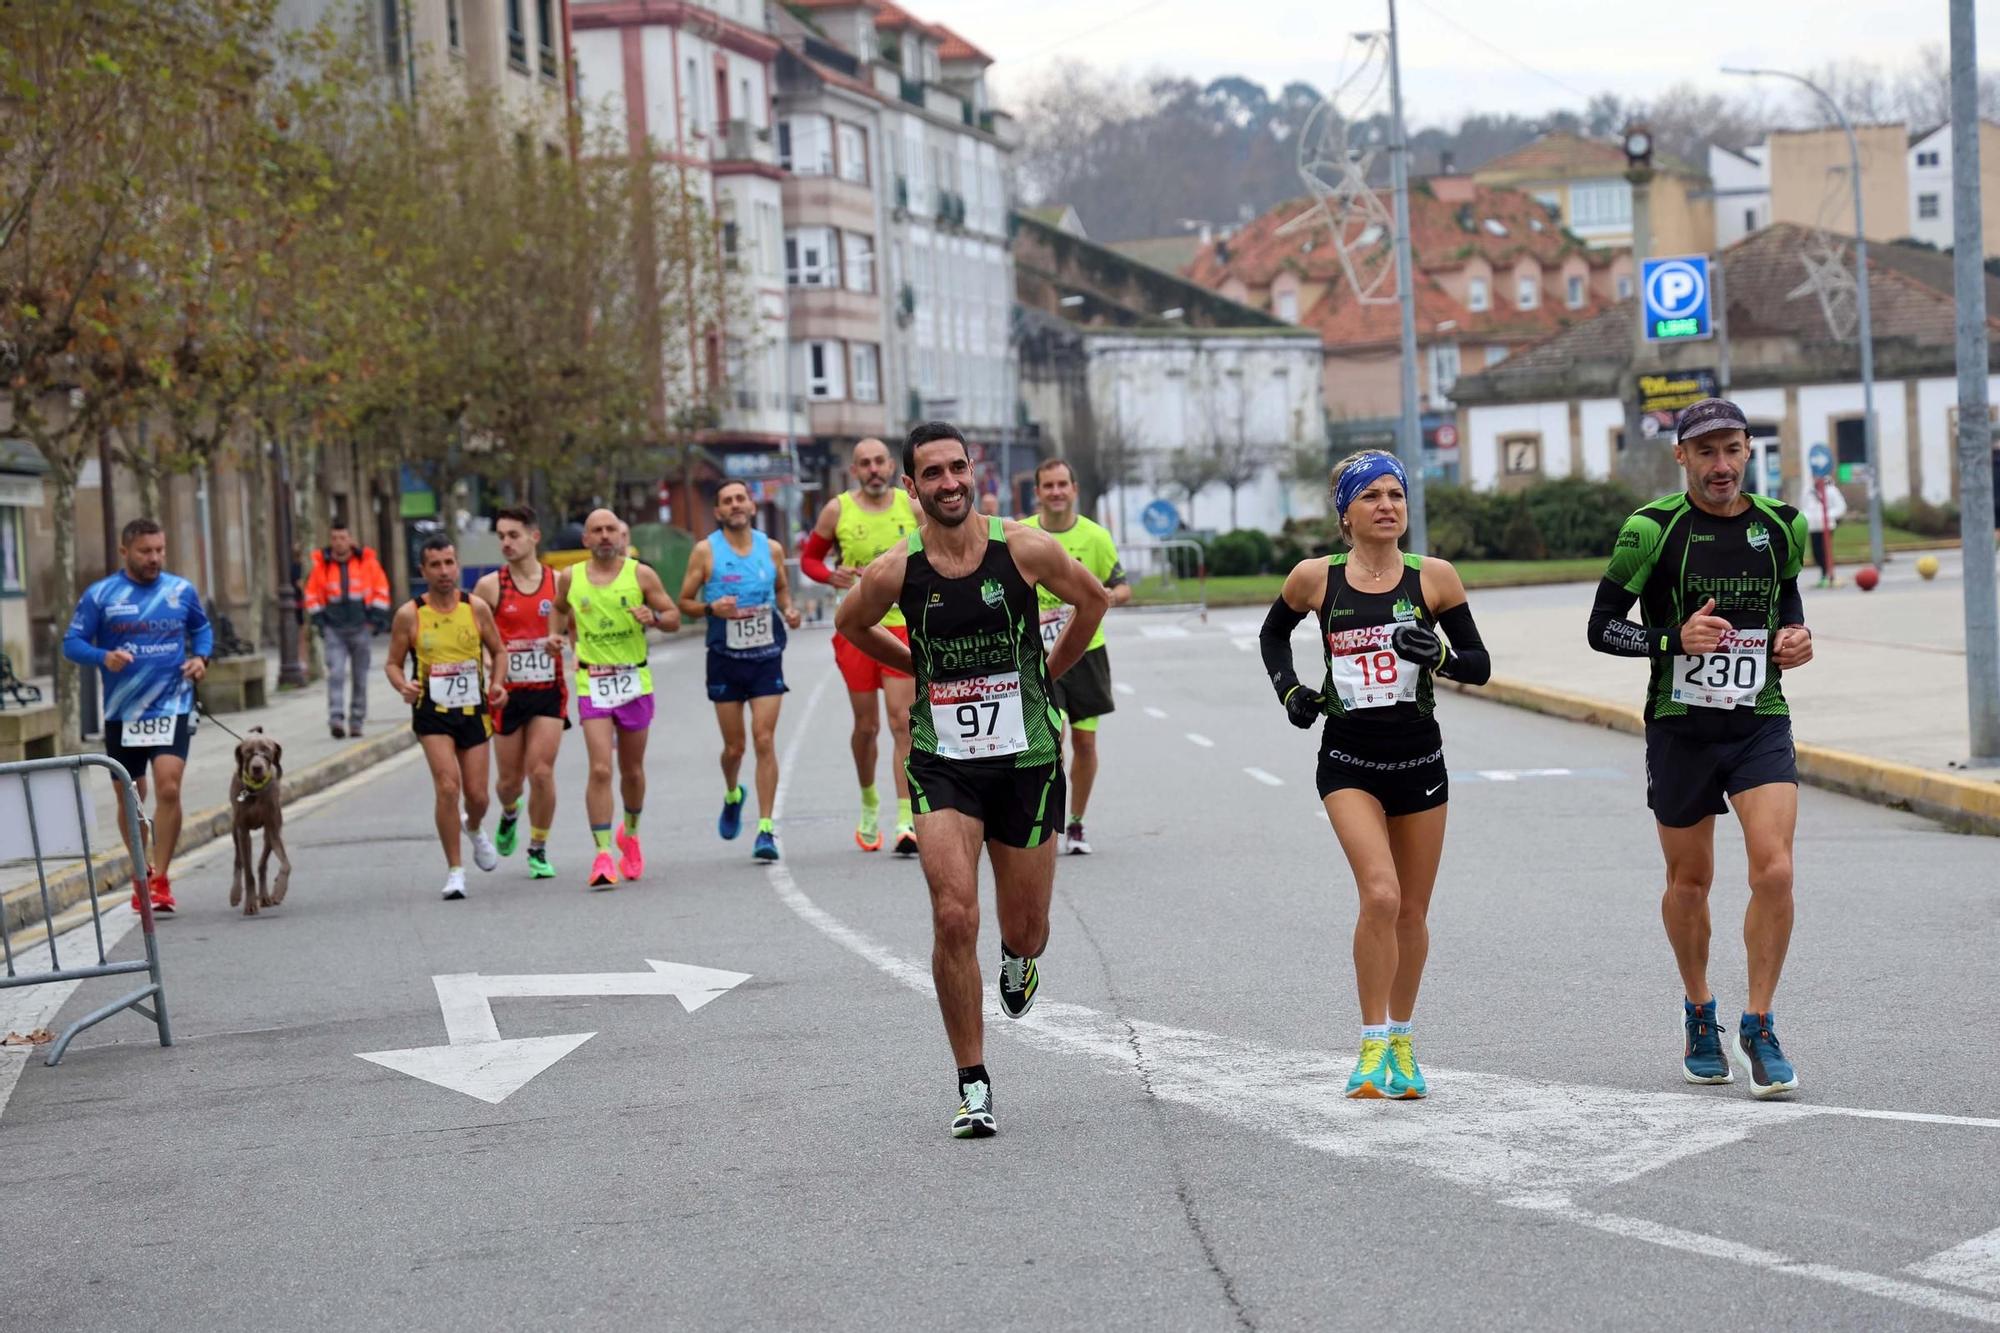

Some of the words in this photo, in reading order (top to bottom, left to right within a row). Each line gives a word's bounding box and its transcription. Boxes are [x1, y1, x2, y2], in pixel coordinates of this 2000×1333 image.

[1661, 271, 1694, 310] P
[1688, 571, 1772, 595] Running
[735, 618, 767, 637] 155
[1331, 626, 1385, 641] MEDIO
[931, 629, 1009, 652] Running
[1334, 634, 1391, 649] MARAT
[1603, 630, 1649, 654] Running
[510, 652, 550, 672] 840
[943, 647, 1011, 669] Oleiros
[1355, 651, 1398, 686] 18
[1685, 654, 1757, 689] 230
[444, 676, 468, 697] 79
[597, 675, 633, 697] 512
[932, 677, 988, 690] MEDIO
[934, 681, 1018, 699] MARATÓN
[129, 716, 171, 735] 388
[956, 702, 1000, 738] 97
[1329, 749, 1441, 771] COMPRESSPOR
